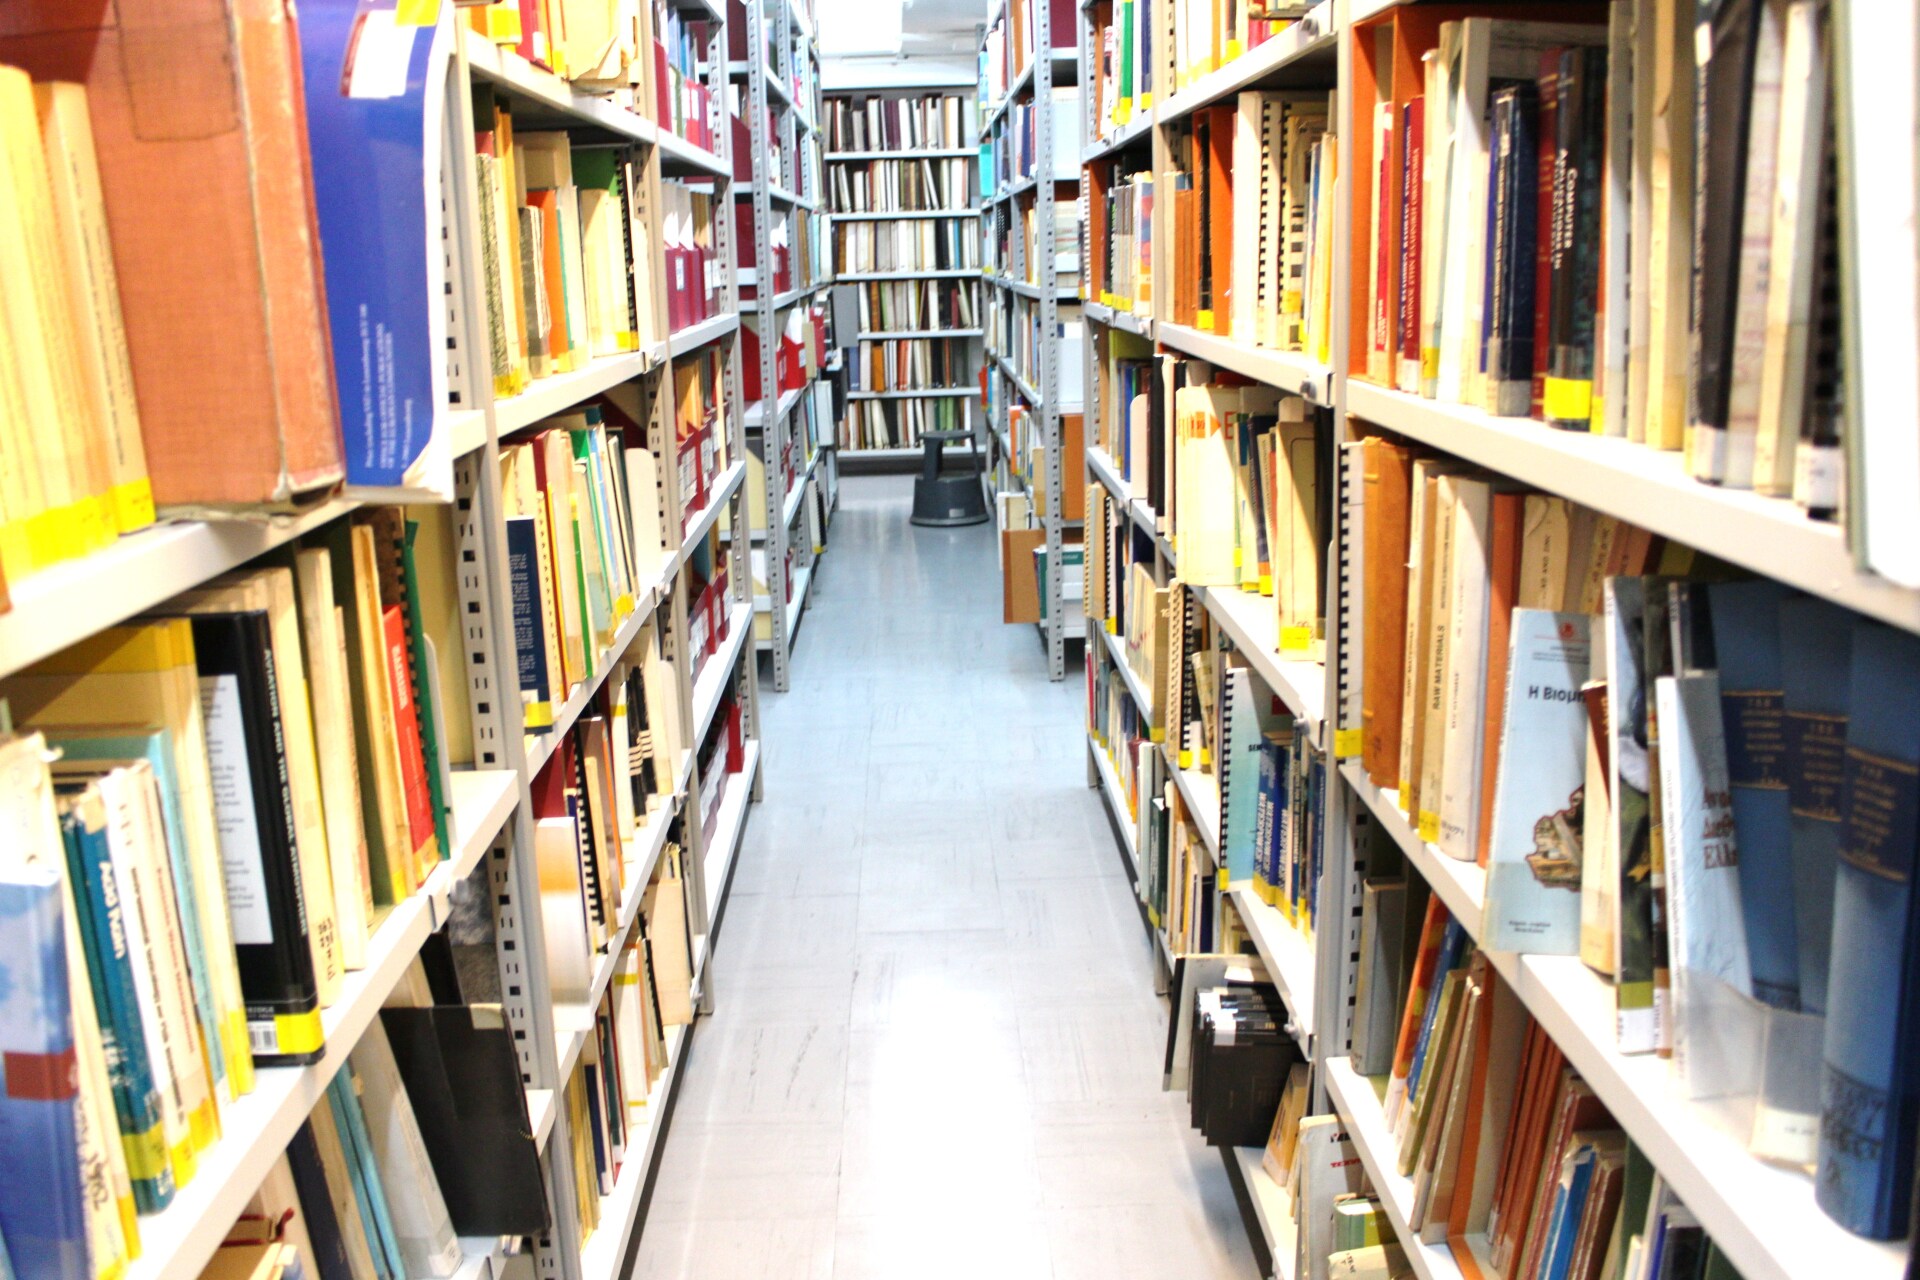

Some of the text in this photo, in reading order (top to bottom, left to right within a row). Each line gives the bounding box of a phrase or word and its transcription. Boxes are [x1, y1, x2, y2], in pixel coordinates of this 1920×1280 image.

[1564, 167, 1578, 249] COMPUTER
[1433, 624, 1446, 684] MATERIALS
[1432, 685, 1443, 711] RAW
[264, 648, 308, 937] AVIATION AND THE GLOBAL ATMOSPHERE
[98, 860, 127, 959] Acid Rain
